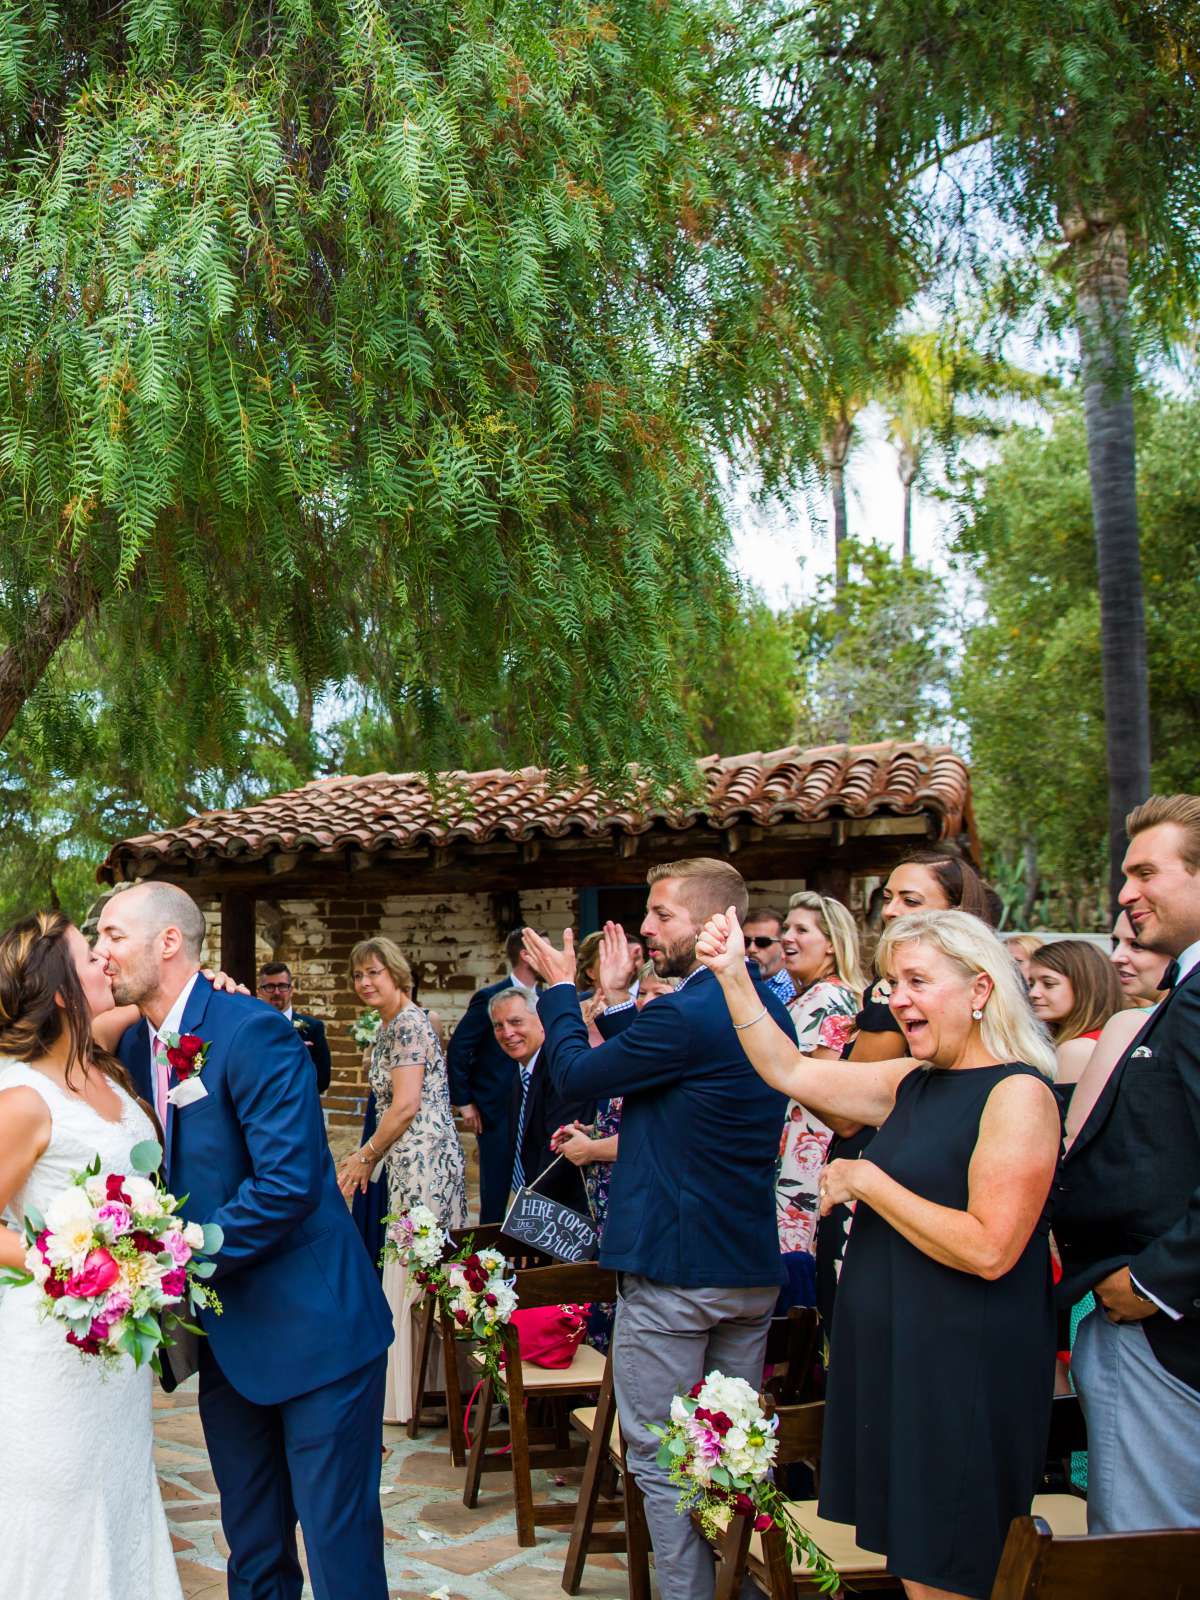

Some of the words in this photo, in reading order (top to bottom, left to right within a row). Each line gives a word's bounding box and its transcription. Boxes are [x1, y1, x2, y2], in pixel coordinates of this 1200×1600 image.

[516, 1219, 534, 1229] the
[521, 1200, 555, 1221] HERE
[557, 1209, 597, 1246] COMES
[524, 1221, 587, 1262] Bride
